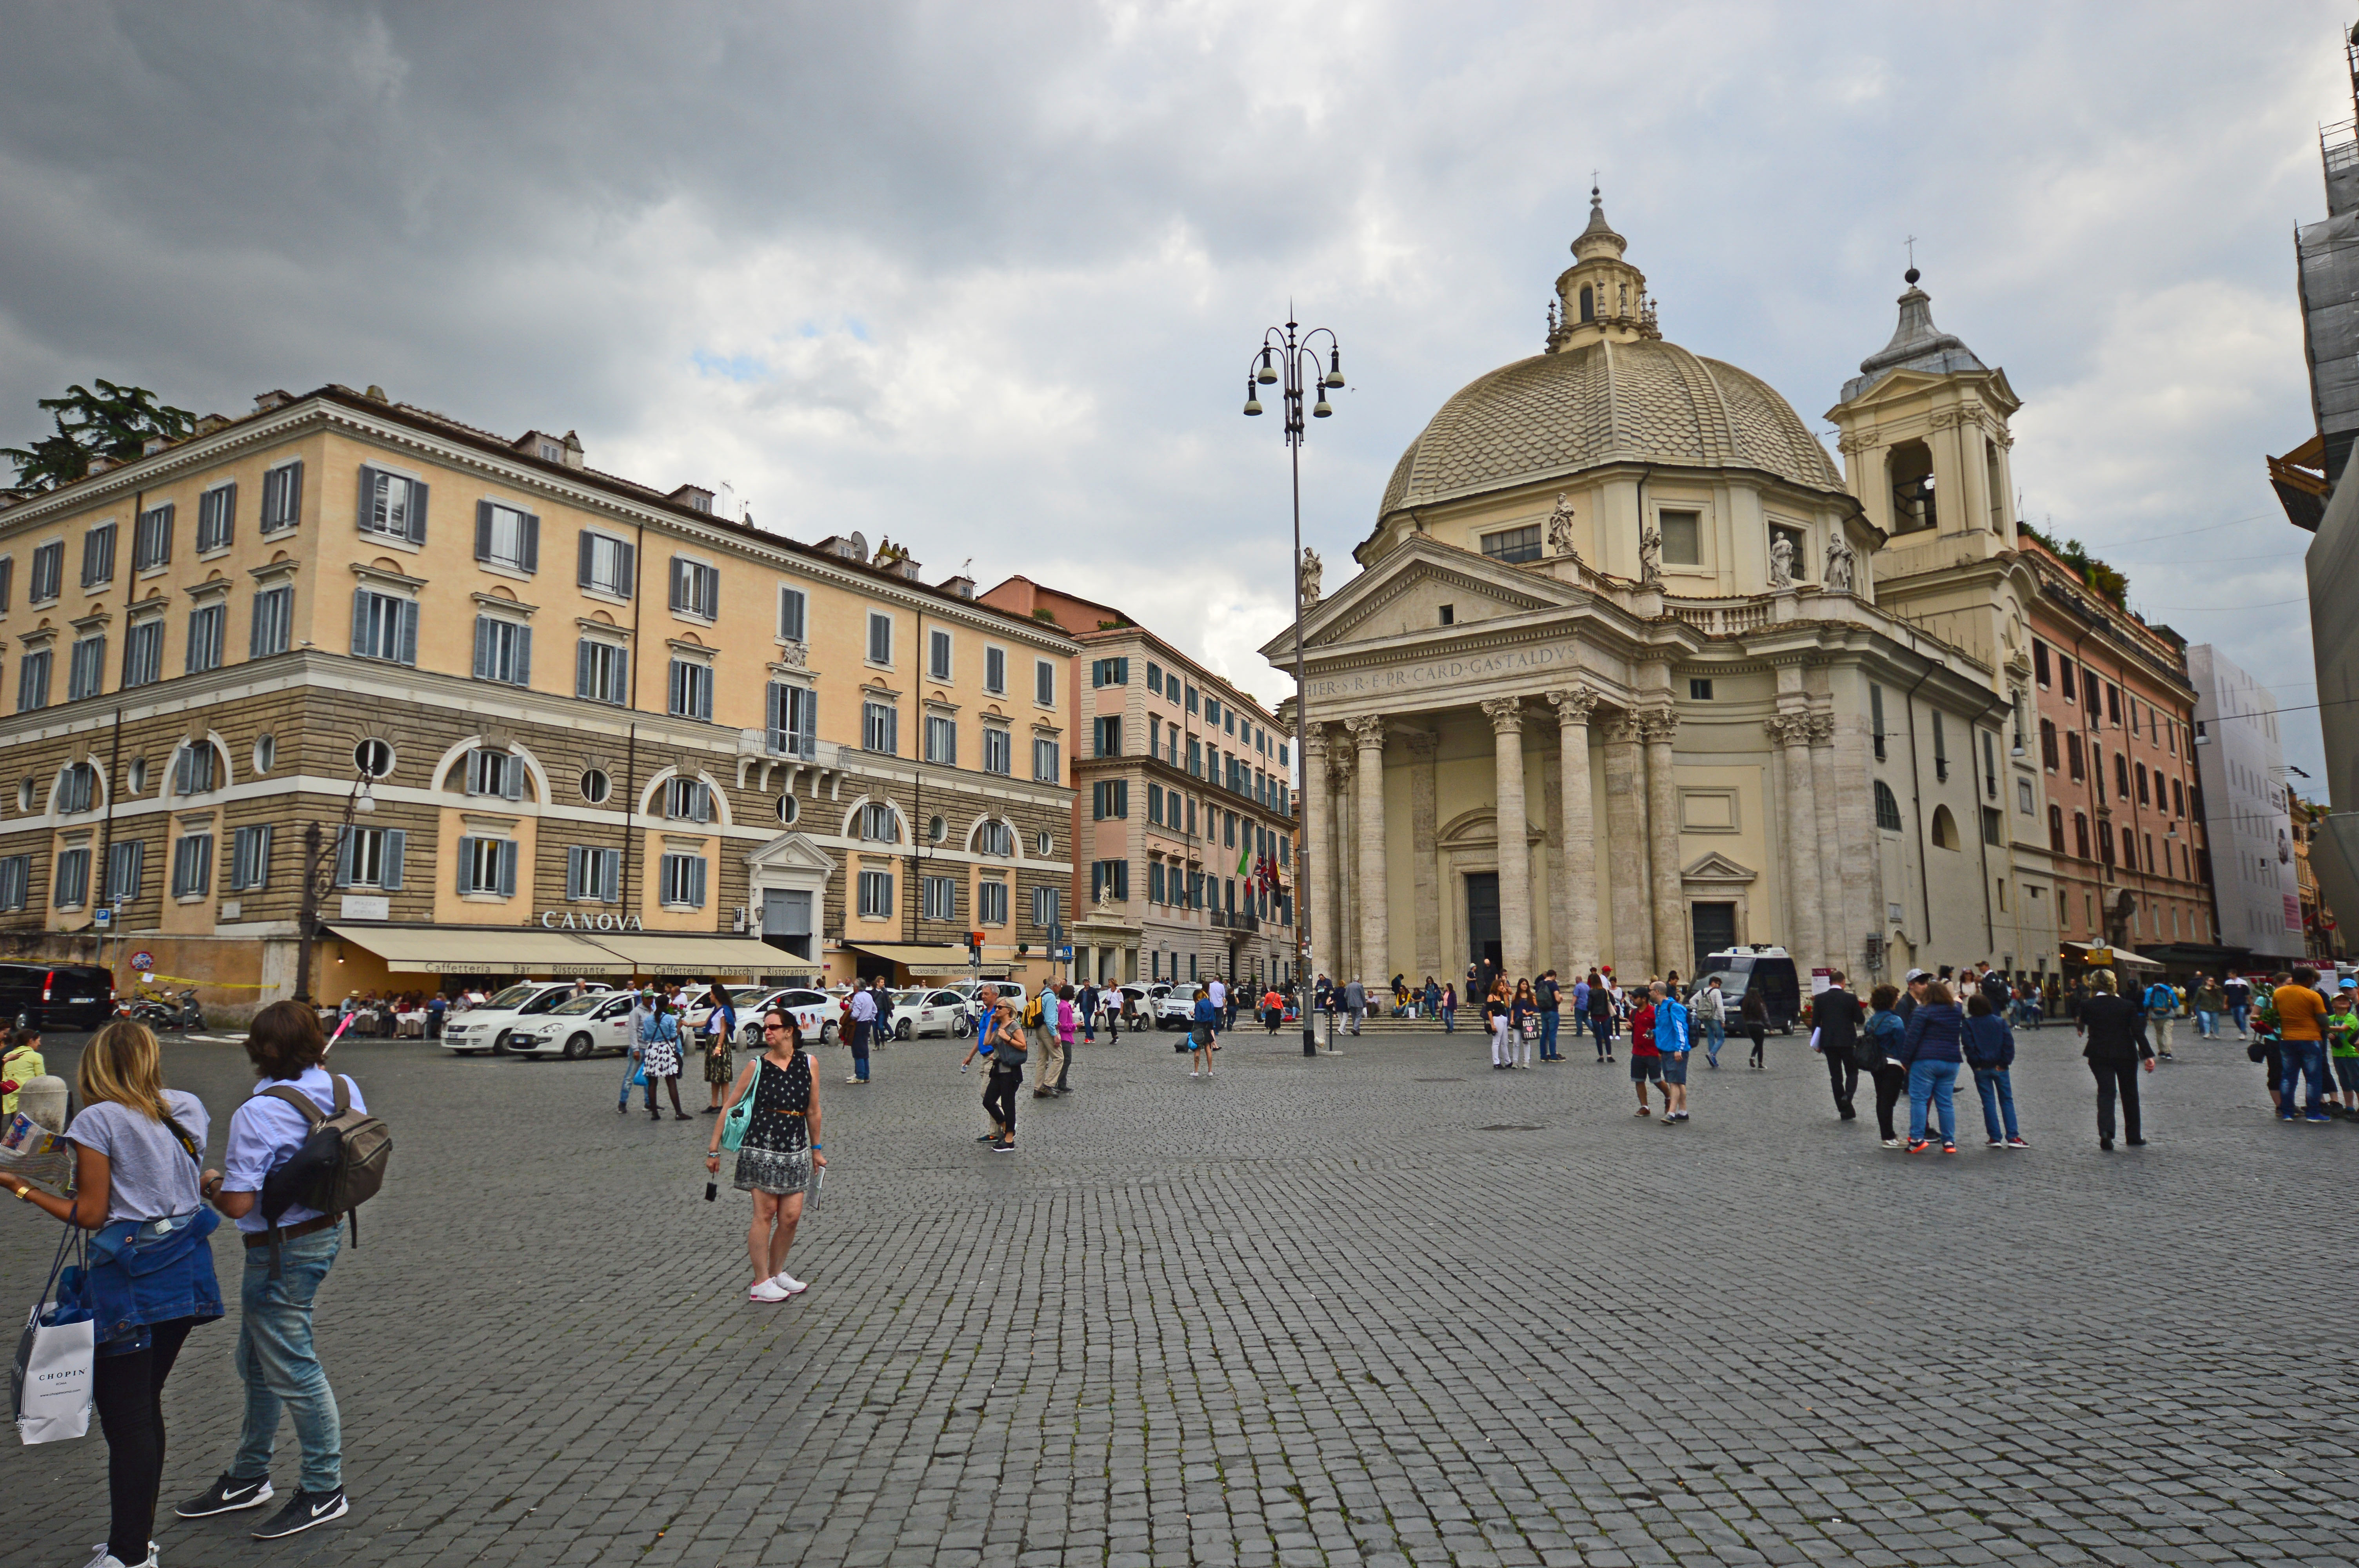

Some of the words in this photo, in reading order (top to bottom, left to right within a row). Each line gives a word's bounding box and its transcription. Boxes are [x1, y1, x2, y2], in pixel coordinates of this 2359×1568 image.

[1355, 677, 1365, 690] R
[1372, 675, 1379, 688] E
[1387, 671, 1407, 686] PR
[1414, 662, 1463, 681] CARD
[1470, 645, 1576, 673] GASTALDVS
[542, 911, 643, 931] CANOVA
[425, 962, 491, 973] Caffetteria
[514, 964, 531, 974] Bar
[552, 965, 605, 974] Ristorante
[654, 965, 703, 975] Caffetteria
[719, 967, 754, 975] Tabacchi
[39, 1369, 85, 1381] CHOPIN
[40, 1389, 81, 1397] www.chopinroma.com
